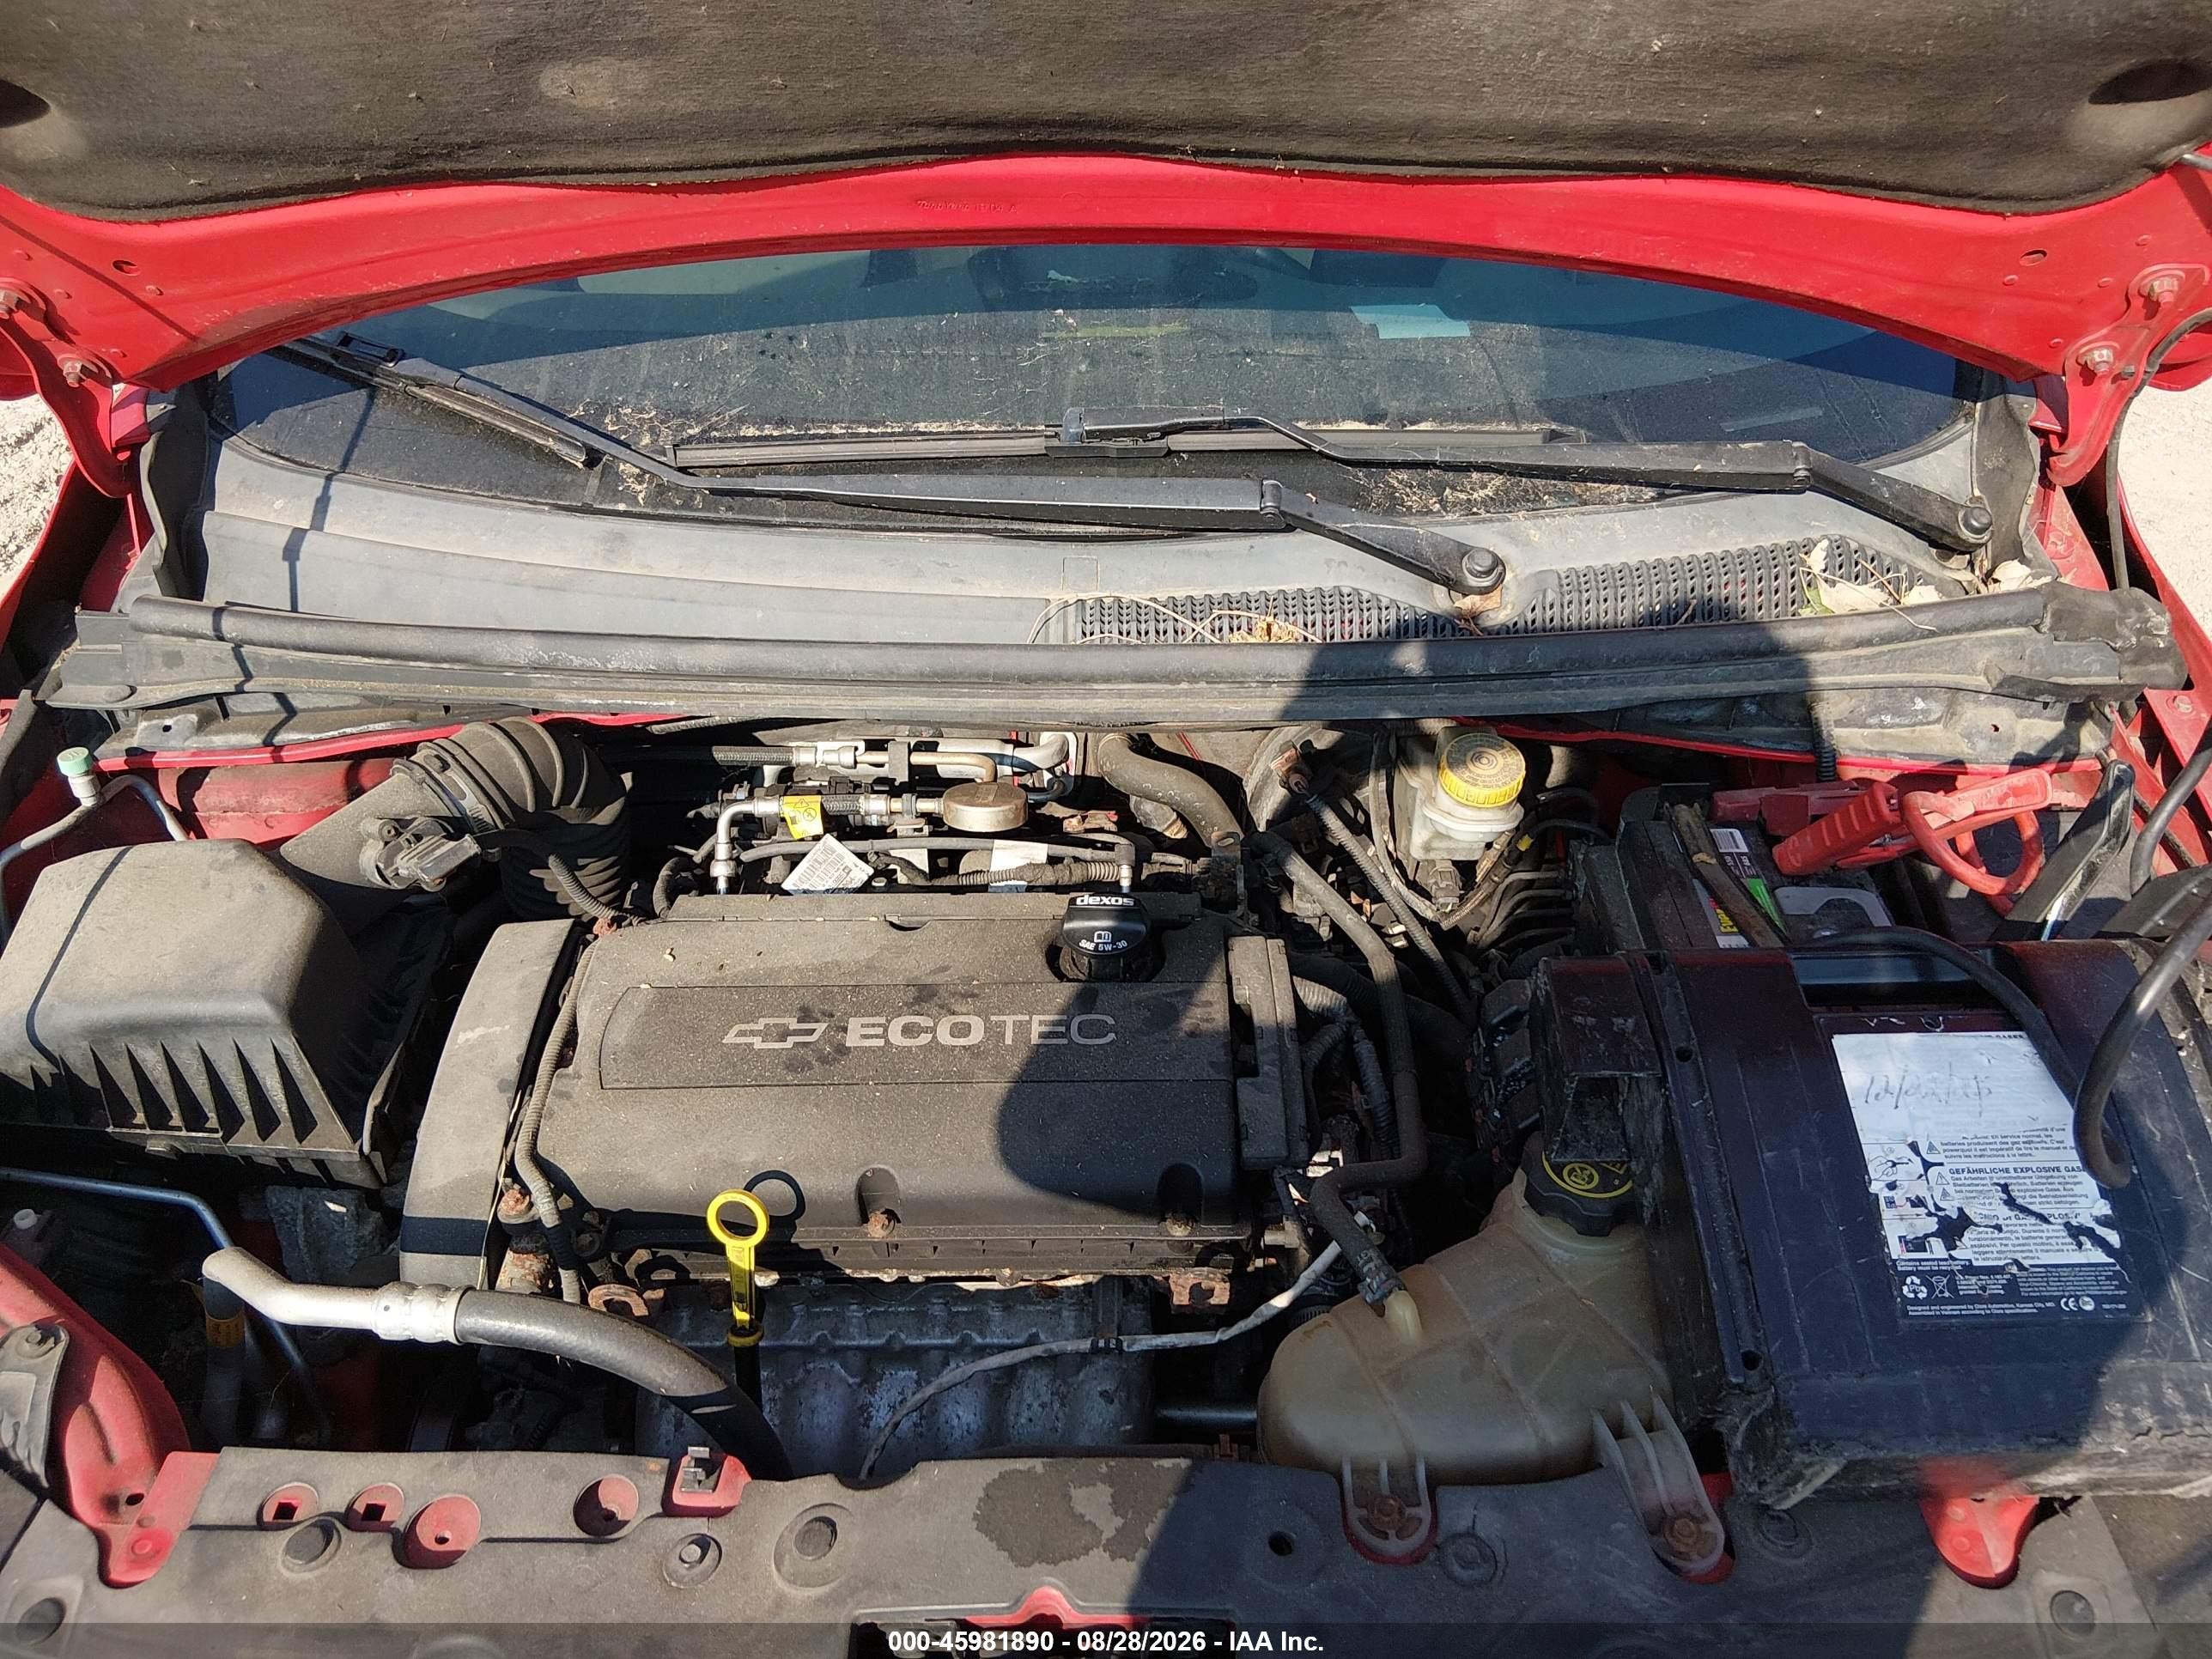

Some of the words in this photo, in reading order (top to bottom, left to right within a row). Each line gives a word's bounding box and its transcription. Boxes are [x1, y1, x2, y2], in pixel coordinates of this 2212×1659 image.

[1075, 894, 1134, 906] dexos
[1079, 939, 1097, 951] SAE
[1097, 939, 1128, 951] 5W-30
[845, 1014, 1115, 1047] ECOTEC
[1948, 1166, 2011, 1175] GEFÄHRLICHE
[2013, 1165, 2062, 1174] EXPLOSIVE
[2060, 1297, 2078, 1311] CE
